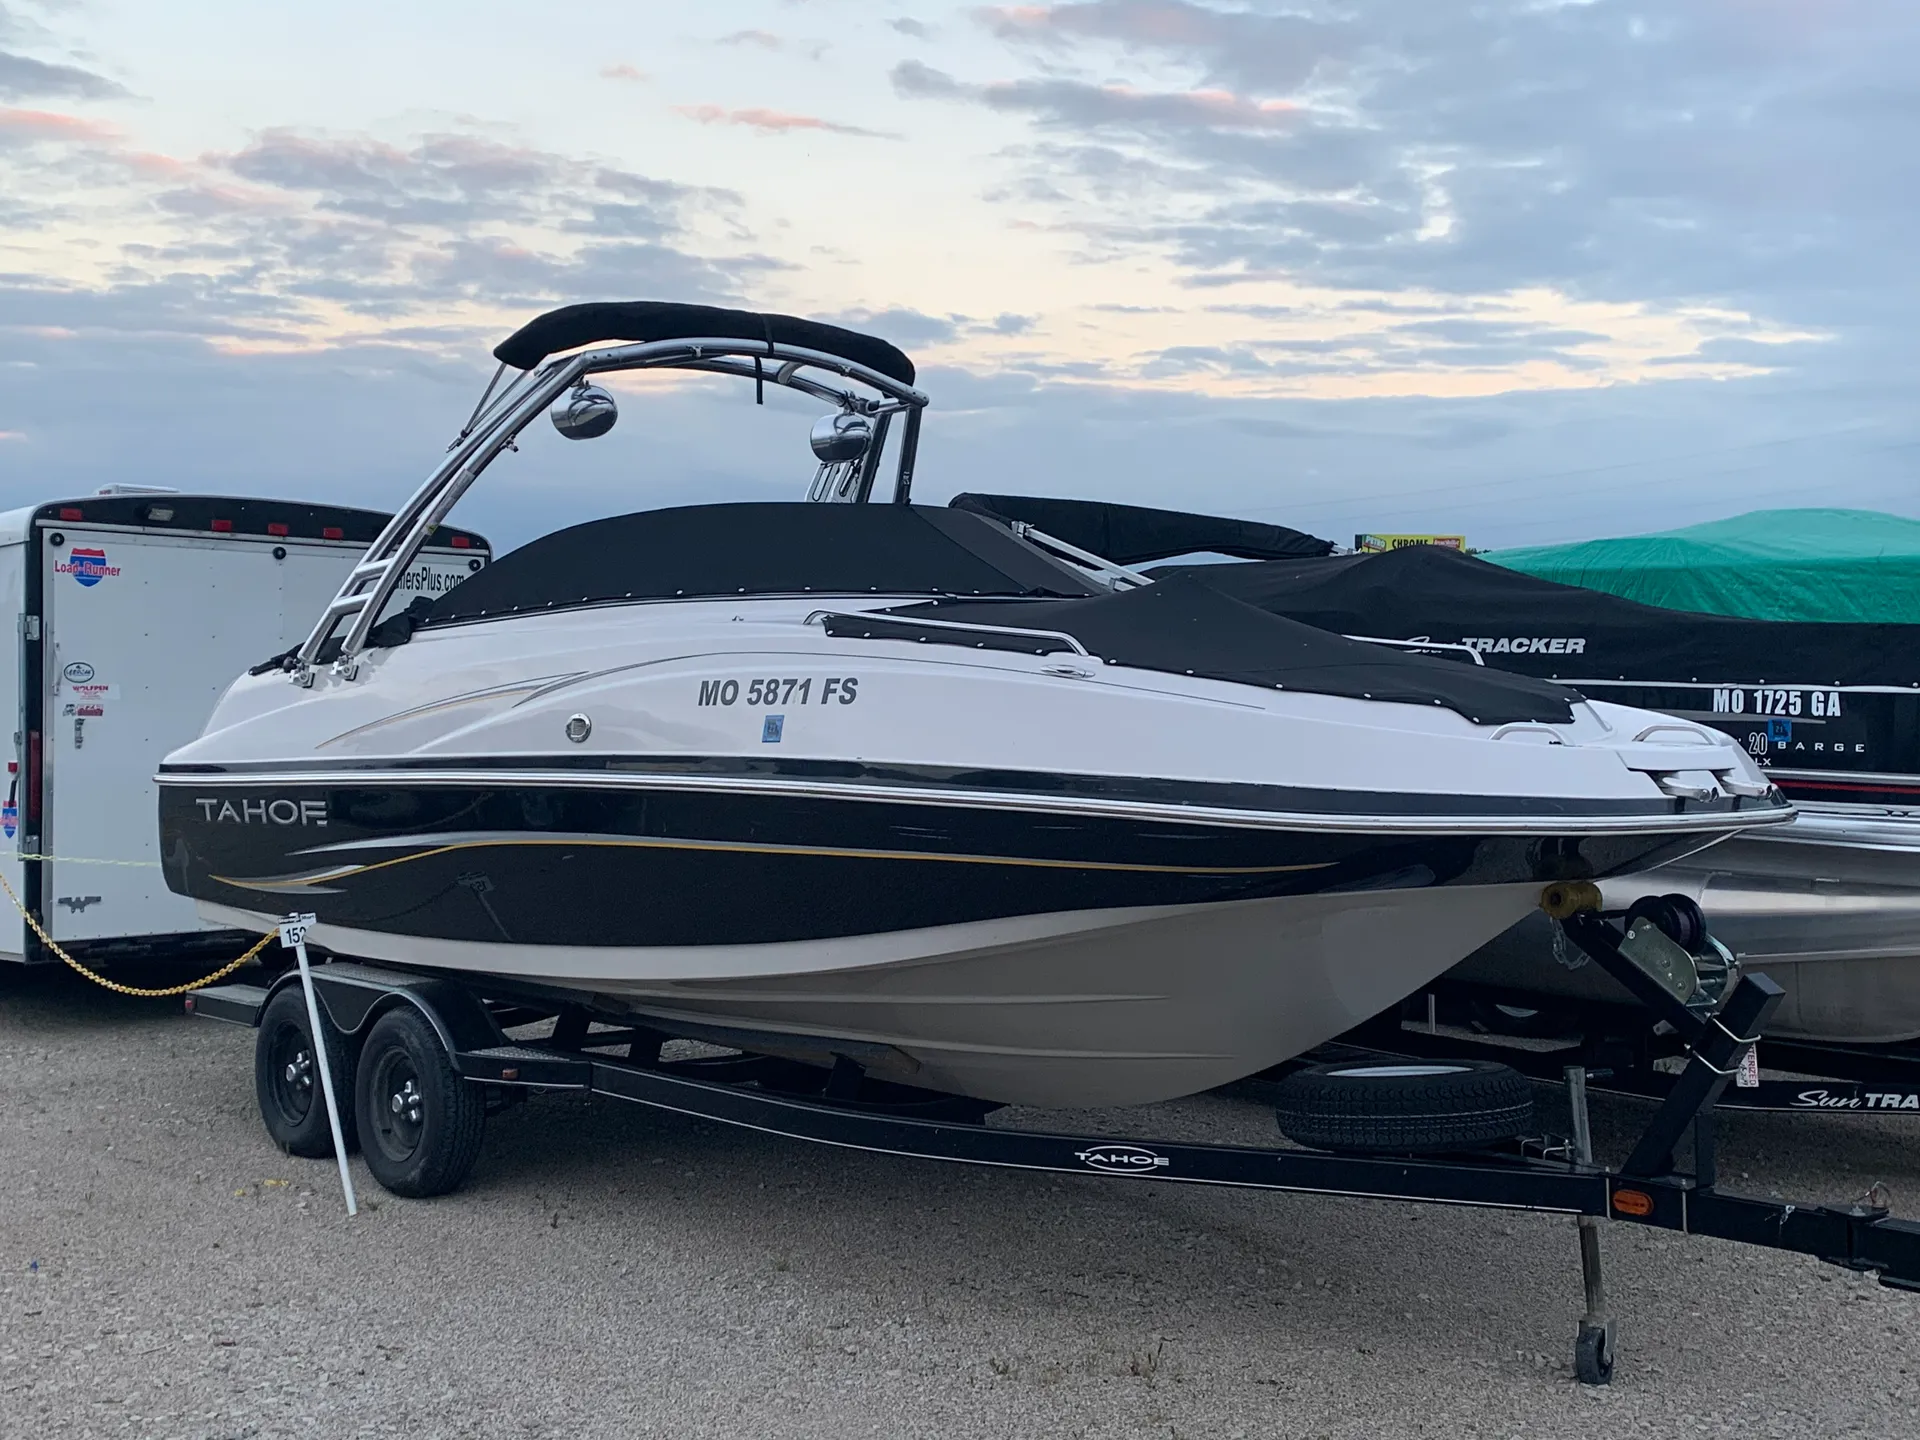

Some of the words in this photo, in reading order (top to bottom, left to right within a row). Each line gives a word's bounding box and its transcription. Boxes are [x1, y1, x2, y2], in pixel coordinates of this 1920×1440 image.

[1461, 637, 1587, 654] TRACKER
[698, 679, 739, 706] MO
[746, 678, 812, 706] 5871
[820, 677, 859, 705] FS
[1712, 688, 1745, 713] MO
[1753, 689, 1802, 716] 1725
[1811, 692, 1841, 716] GA
[1748, 731, 1768, 755] 20
[1777, 741, 1865, 753] BARGE
[195, 798, 328, 827] TAHOE
[1789, 1089, 1862, 1109] Sun
[1865, 1093, 1920, 1109] TRA
[1074, 1152, 1170, 1166] TAHOE
